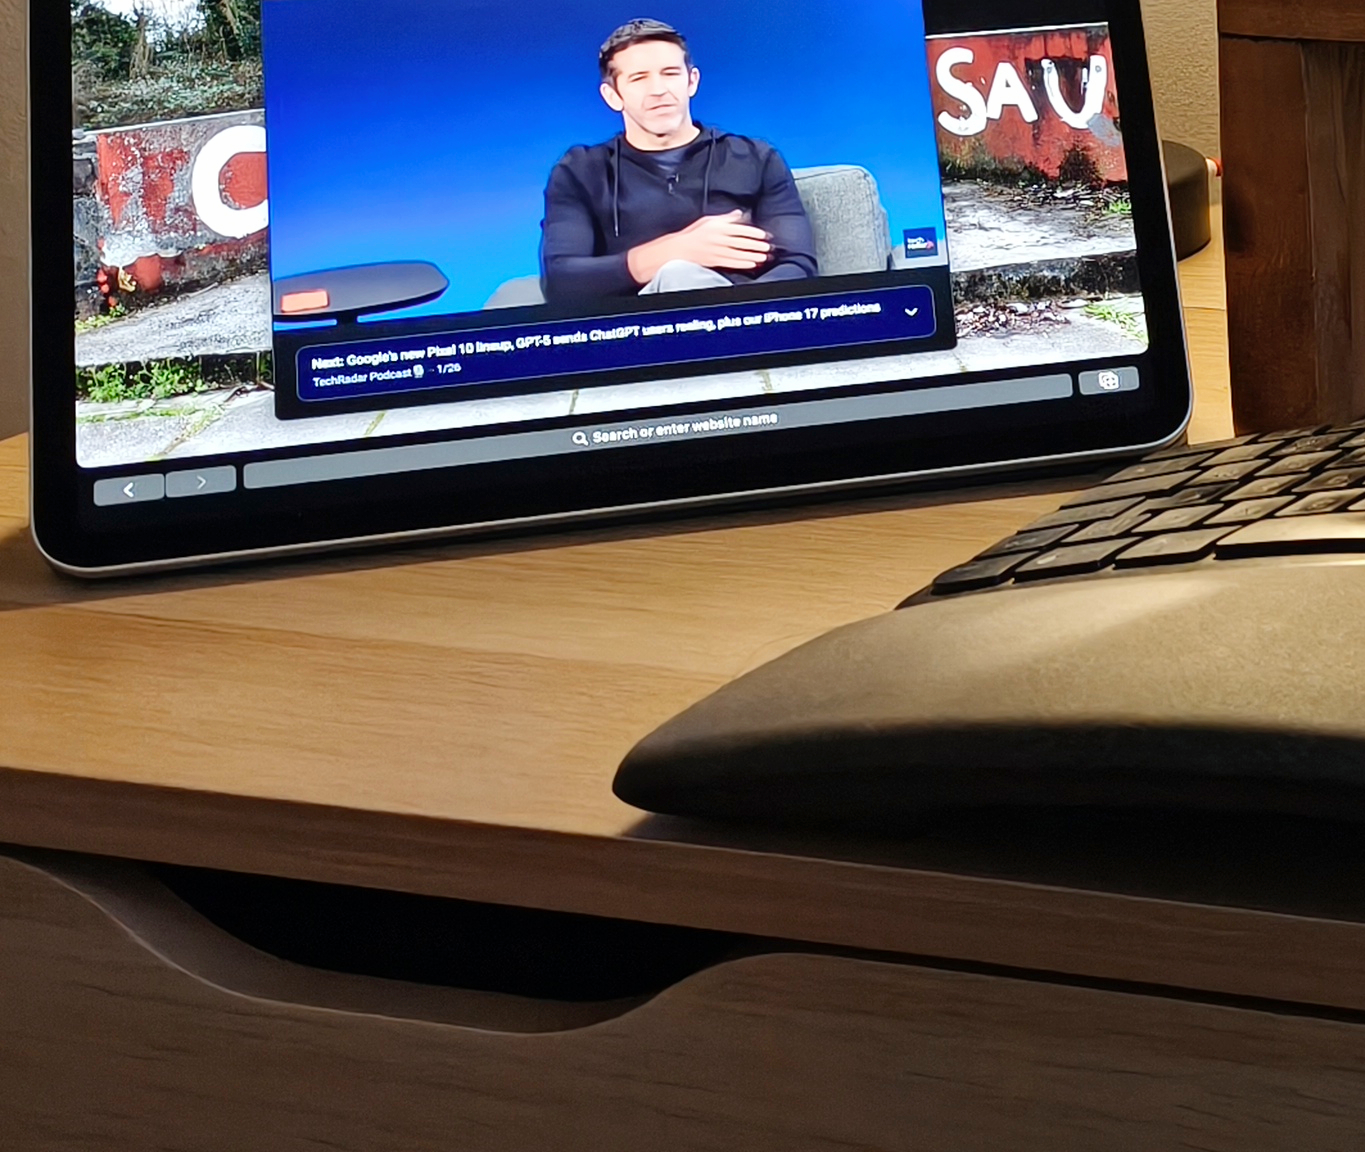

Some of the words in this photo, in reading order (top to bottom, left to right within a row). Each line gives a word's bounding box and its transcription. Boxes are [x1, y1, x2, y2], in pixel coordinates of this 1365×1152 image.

[347, 351, 398, 366] Google's
[400, 350, 425, 361] new
[458, 344, 474, 355] 10
[516, 335, 551, 348] GPT-5
[589, 326, 639, 341] ChatGPT
[804, 308, 818, 319] 17
[820, 302, 881, 319] predictions
[313, 372, 367, 388] TechRadar
[370, 368, 412, 383] Podcast
[593, 427, 638, 444] Search
[640, 427, 654, 438] or
[656, 421, 690, 436] enter
[691, 415, 741, 432] website
[743, 412, 778, 427] name
